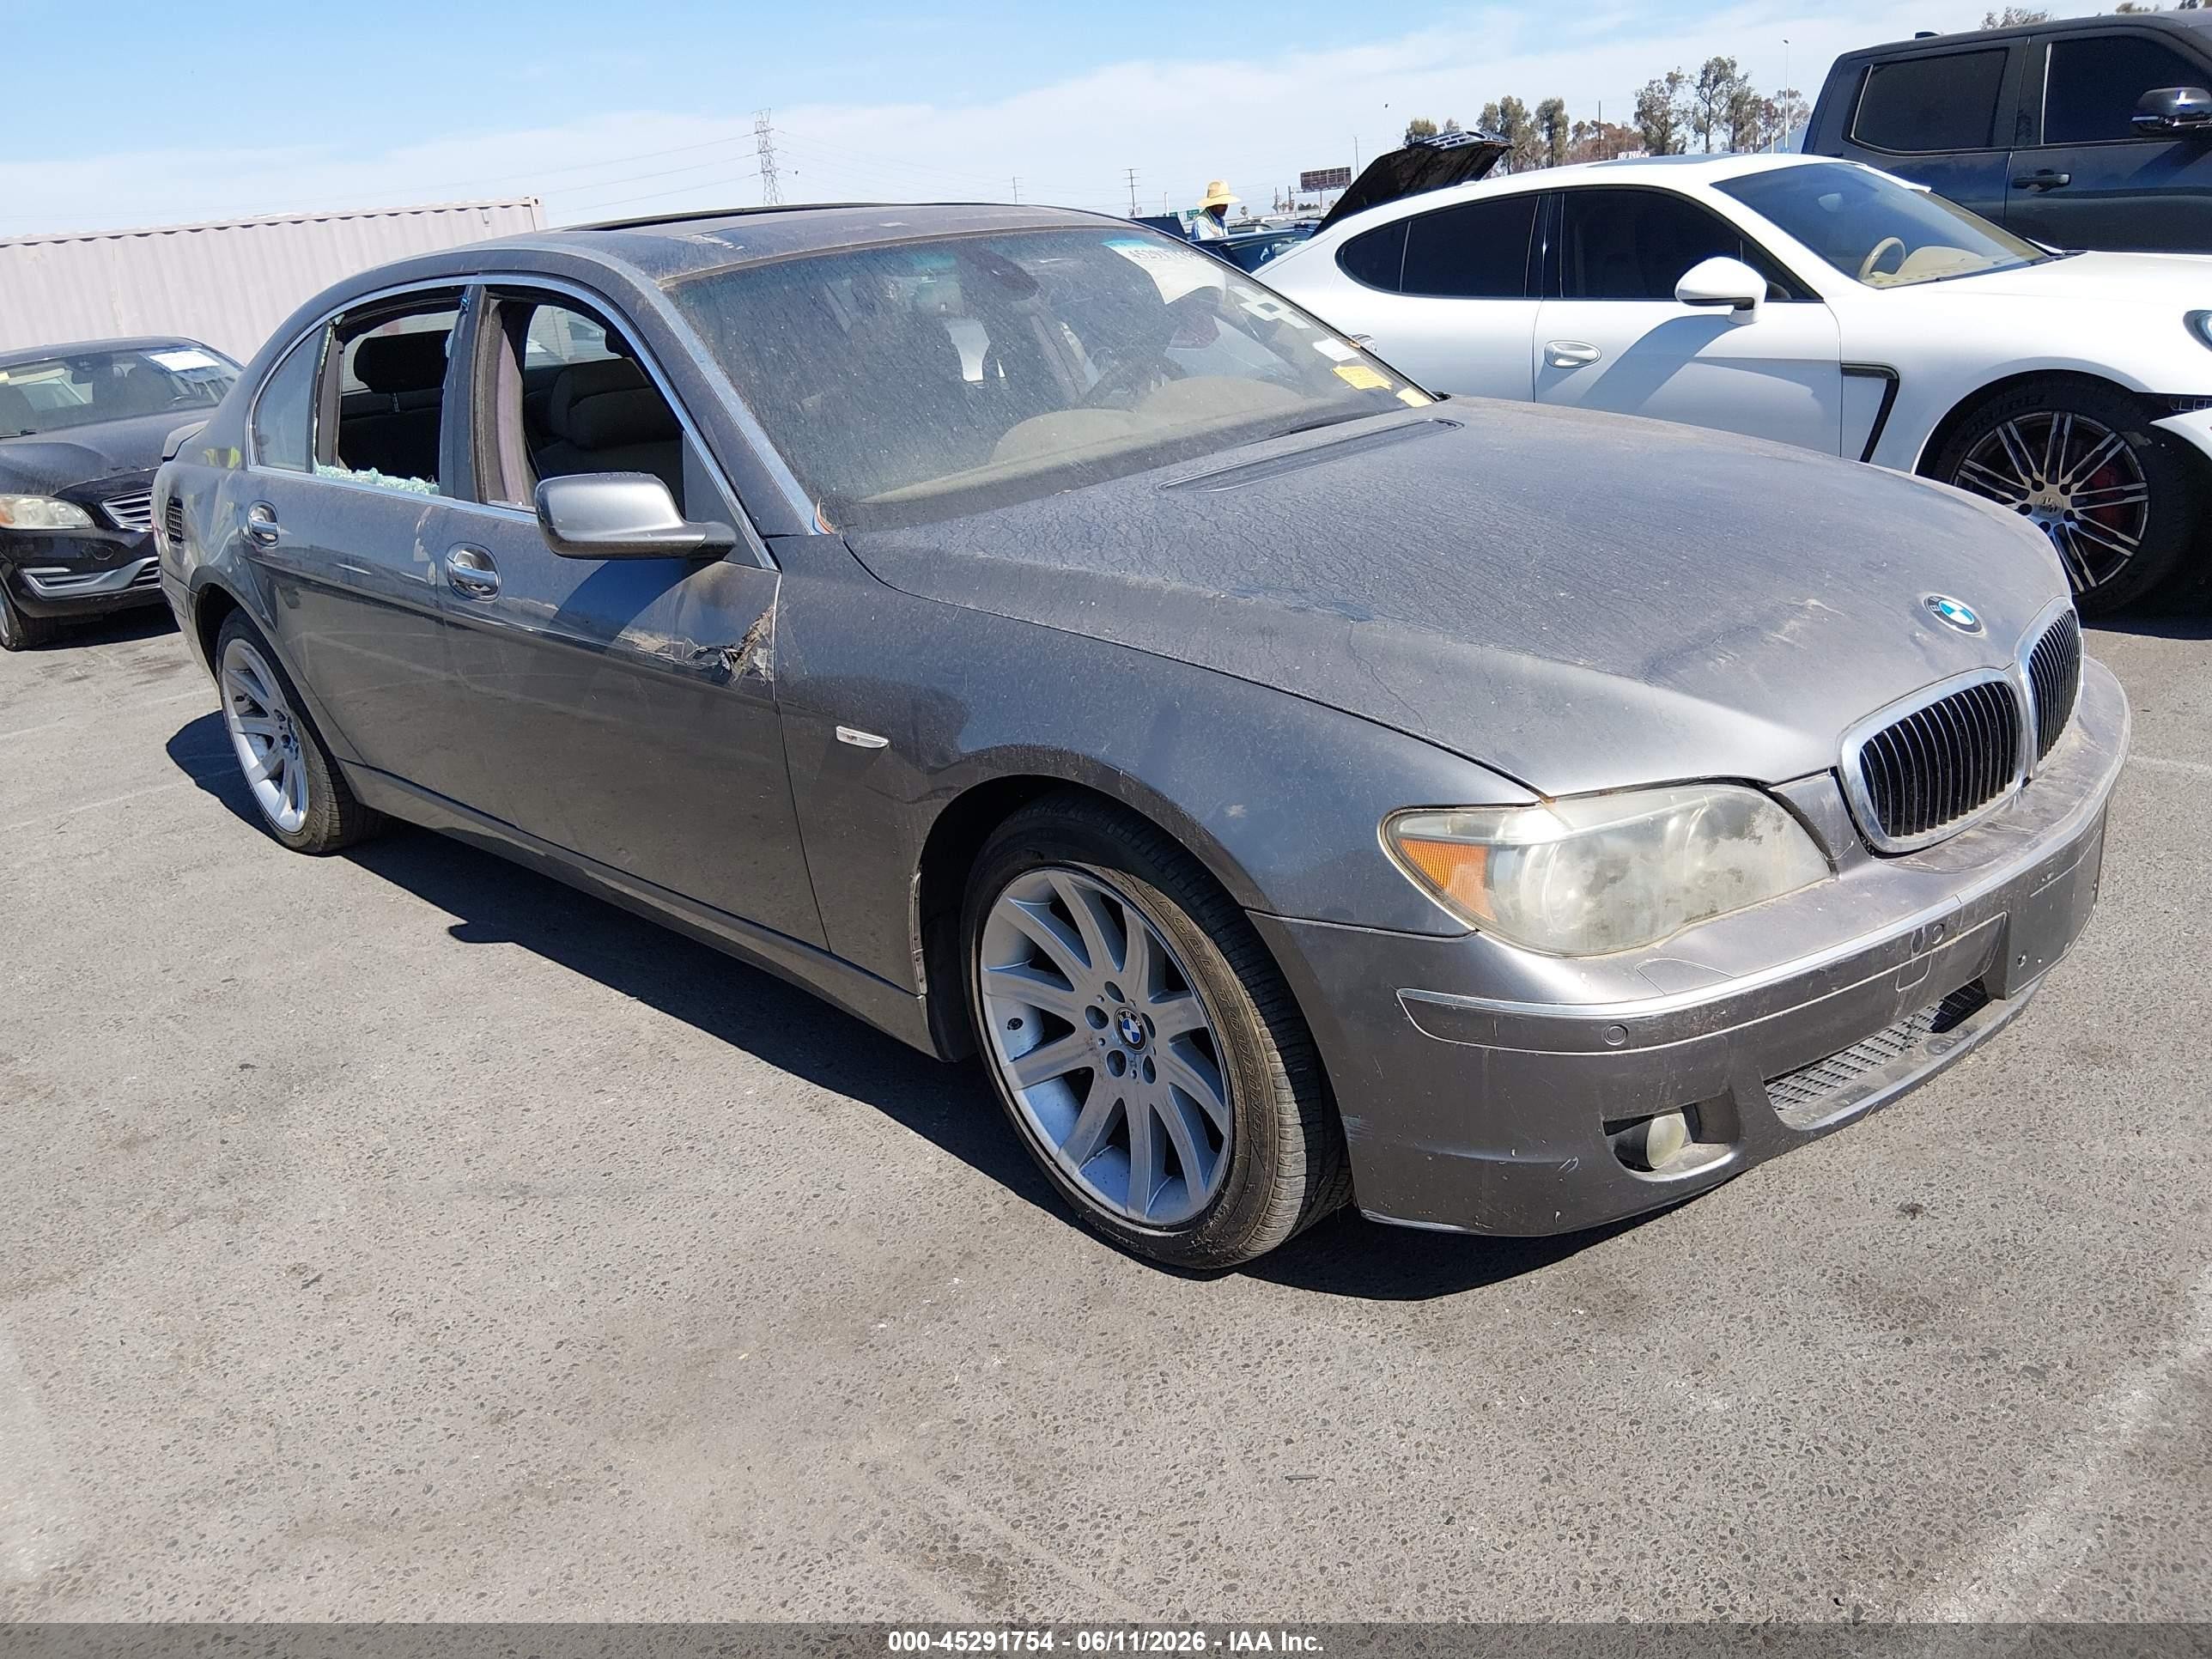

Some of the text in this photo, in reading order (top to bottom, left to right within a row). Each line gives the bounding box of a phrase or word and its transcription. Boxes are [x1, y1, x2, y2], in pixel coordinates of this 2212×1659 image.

[1117, 1011, 1142, 1027] BMW
[1143, 883, 1264, 1134] EAGLE TOURING
